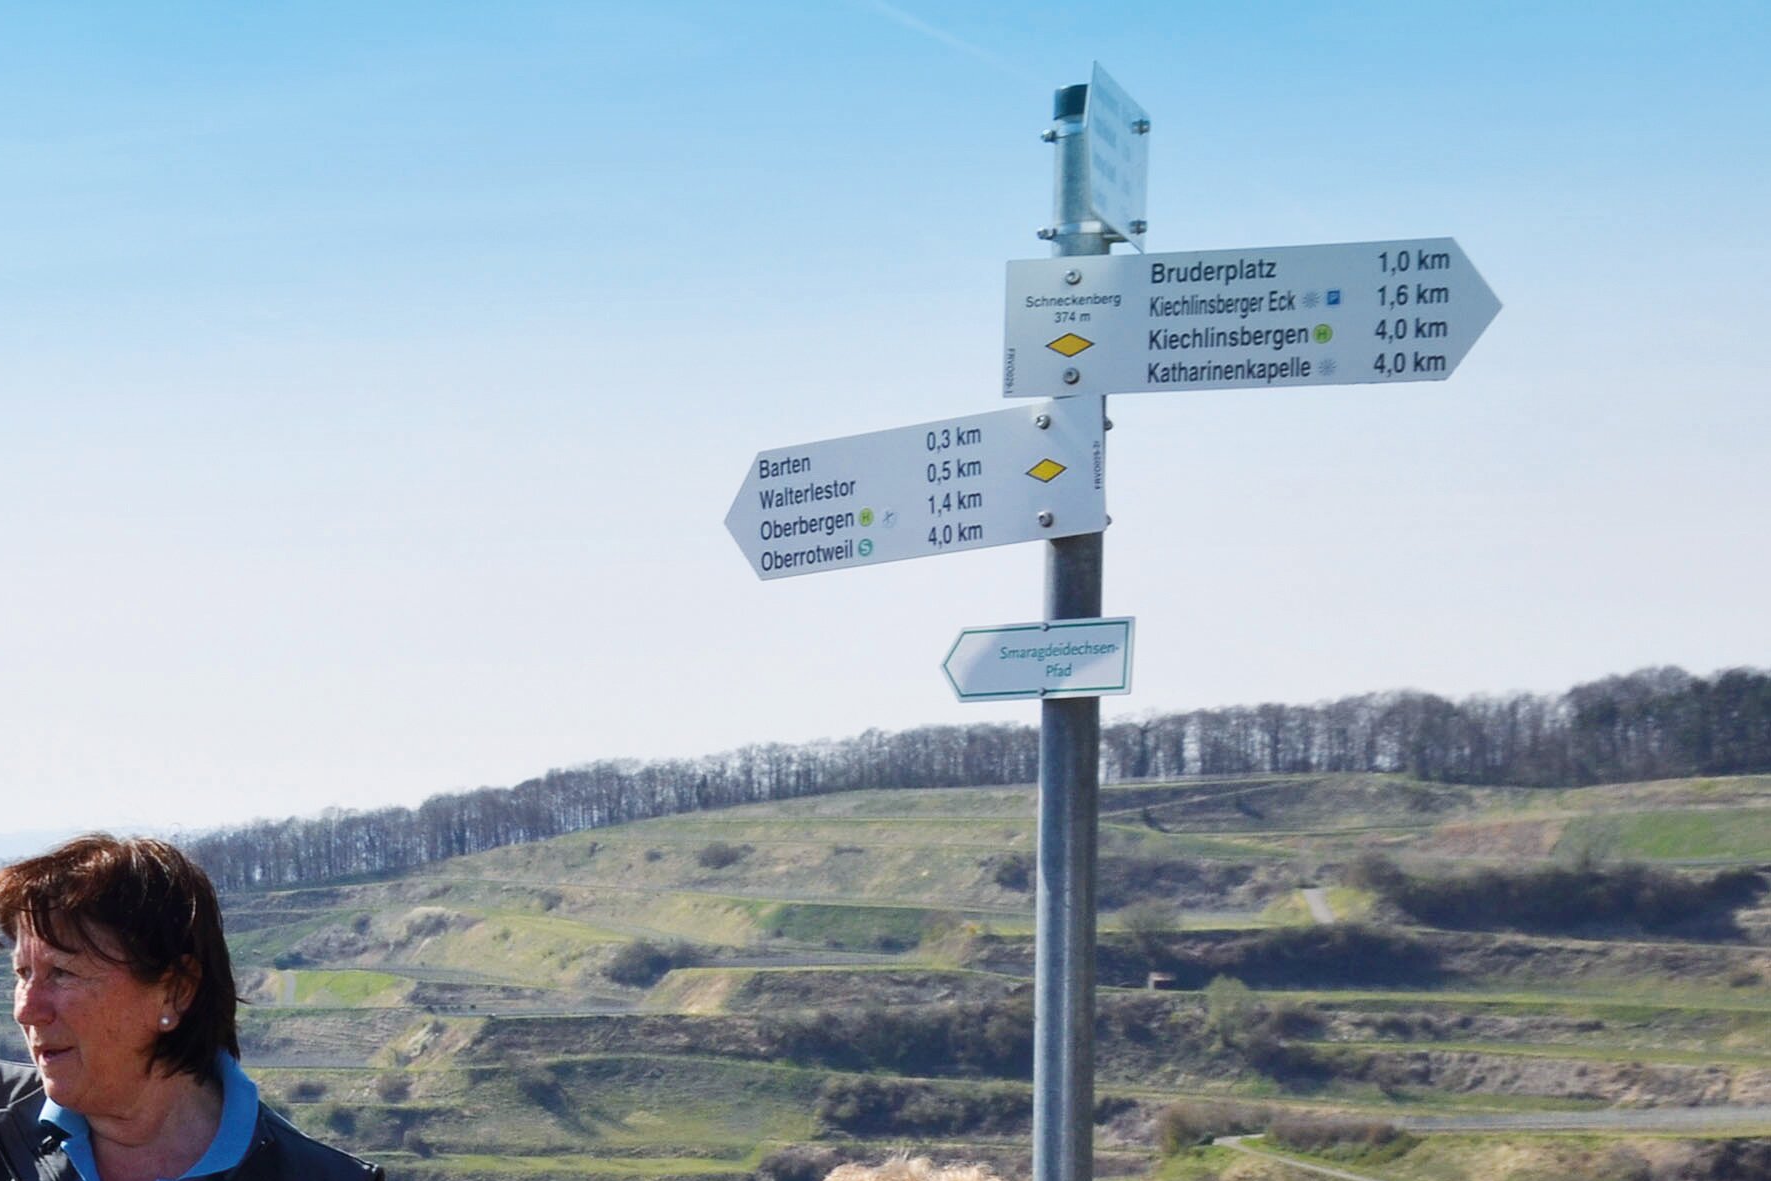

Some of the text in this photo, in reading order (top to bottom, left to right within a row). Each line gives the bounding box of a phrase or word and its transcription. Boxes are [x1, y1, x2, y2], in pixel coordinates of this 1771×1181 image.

[1151, 249, 1450, 285] Bruderplatz 1,0 km
[1025, 294, 1122, 308] Schneckenberg
[1054, 312, 1091, 323] 374 m
[1149, 283, 1449, 318] Kiechlinsberger Eck 1,6 km
[1148, 327, 1309, 351] Kiechlinsbergen
[1375, 318, 1407, 344] 4,0
[1414, 318, 1448, 338] km
[1147, 351, 1446, 384] Katharinenkapelle 4,0 km
[759, 426, 982, 479] Barten 0,3 km
[759, 459, 982, 510] Walterlestor 0,5 km
[760, 511, 854, 541] Oberbergen
[927, 492, 952, 518] 1,4
[957, 490, 982, 510] km
[761, 539, 854, 571] Oberrotweil
[928, 524, 953, 550] 4,0
[958, 522, 983, 542] km
[999, 641, 1120, 662] Smaragdeidechsen-
[1046, 663, 1072, 677] Pfad
